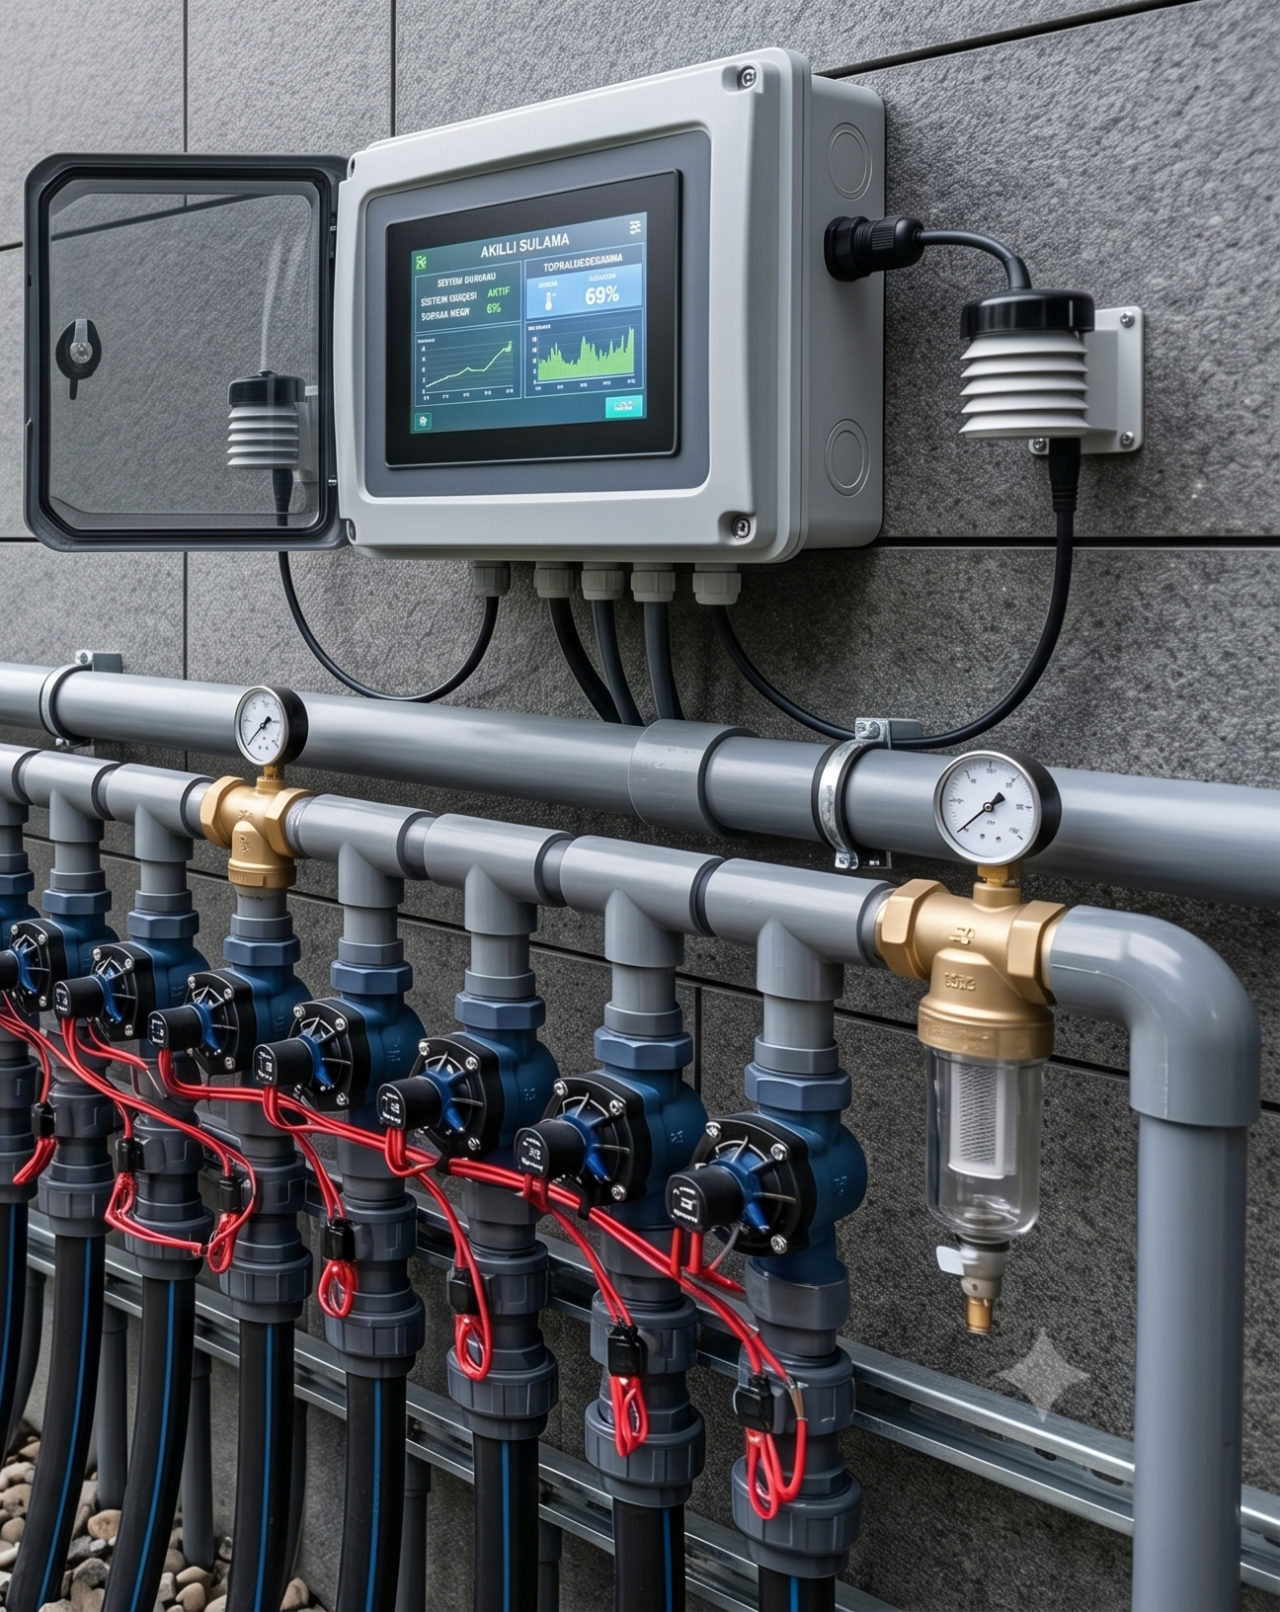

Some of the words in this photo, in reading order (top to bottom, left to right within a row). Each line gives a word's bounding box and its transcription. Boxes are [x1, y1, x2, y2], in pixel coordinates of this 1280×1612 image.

[480, 240, 517, 258] AKILLI
[519, 232, 570, 252] SULAMA
[585, 284, 620, 305] 69%
